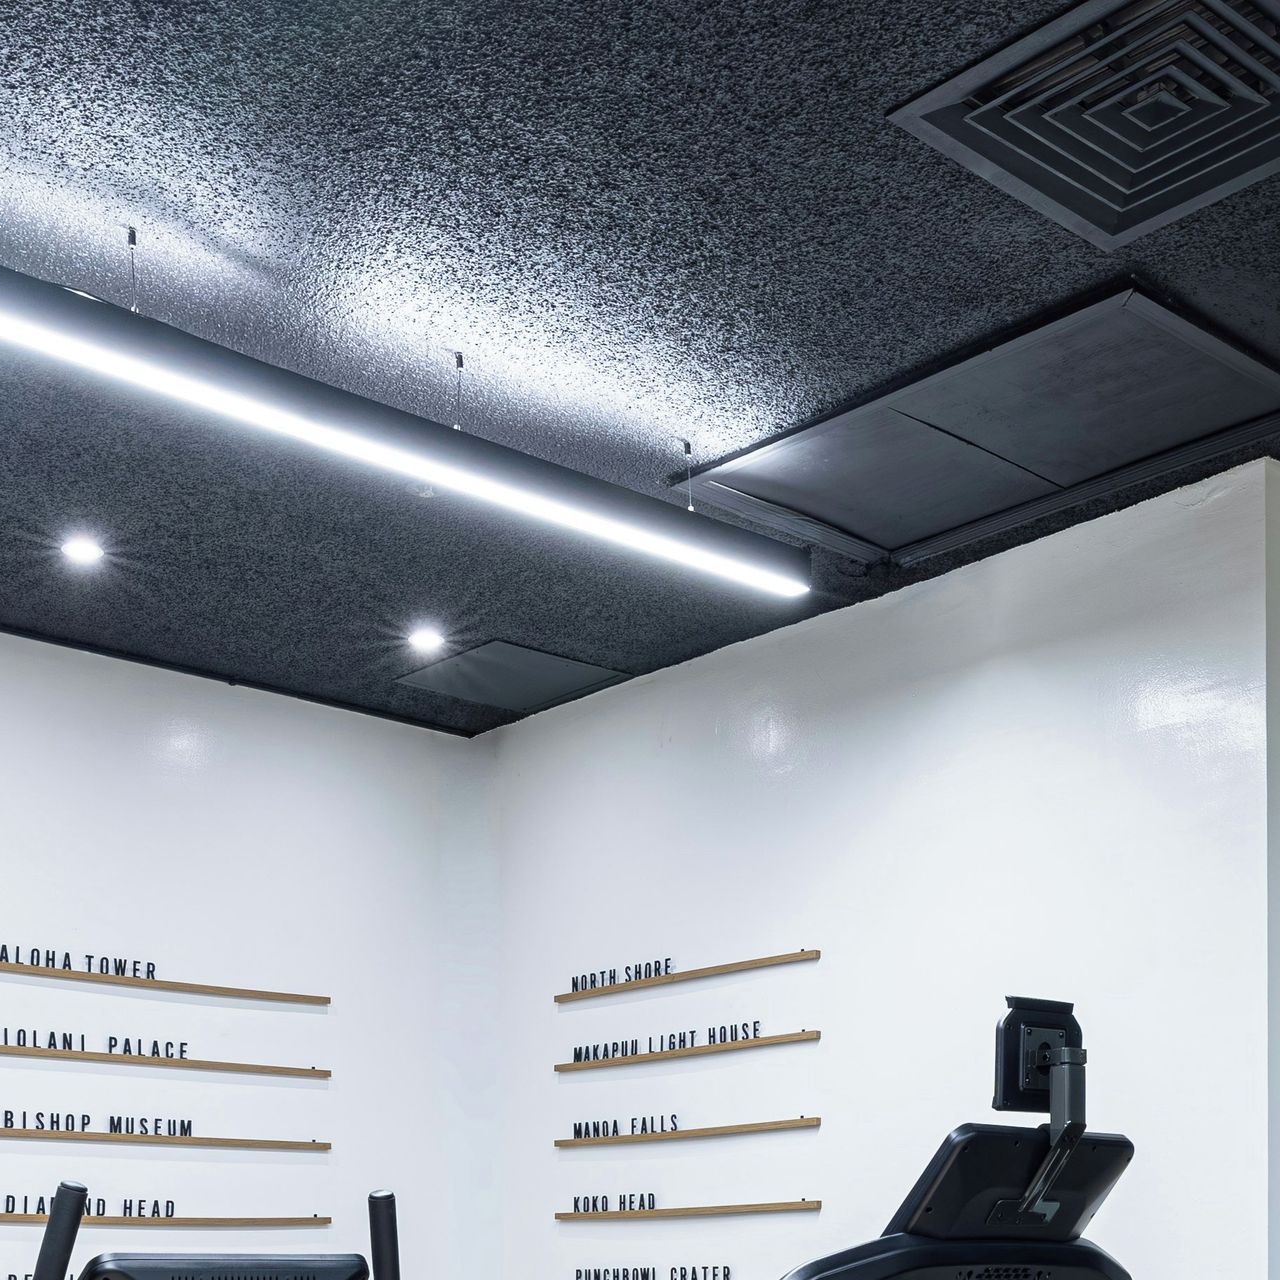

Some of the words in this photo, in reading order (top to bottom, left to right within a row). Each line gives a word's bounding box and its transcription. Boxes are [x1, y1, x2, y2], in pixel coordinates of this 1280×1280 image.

[85, 954, 156, 980] TOWER
[571, 968, 616, 993] NORTH
[625, 958, 672, 982] SHORE
[109, 1036, 188, 1060] PALACE
[573, 1039, 638, 1061] MAKAPUU
[648, 1030, 696, 1054] LIGHT
[708, 1020, 760, 1045] HOUSE
[4, 1110, 91, 1132] BISHOP
[110, 1116, 192, 1137] MUSEUM
[573, 1119, 619, 1140] MANOA
[631, 1114, 678, 1135] FALLS
[6, 1194, 106, 1217] DIAND
[123, 1199, 175, 1218] HEAD
[574, 1195, 608, 1213] KOKO
[619, 1193, 655, 1211] HEAD
